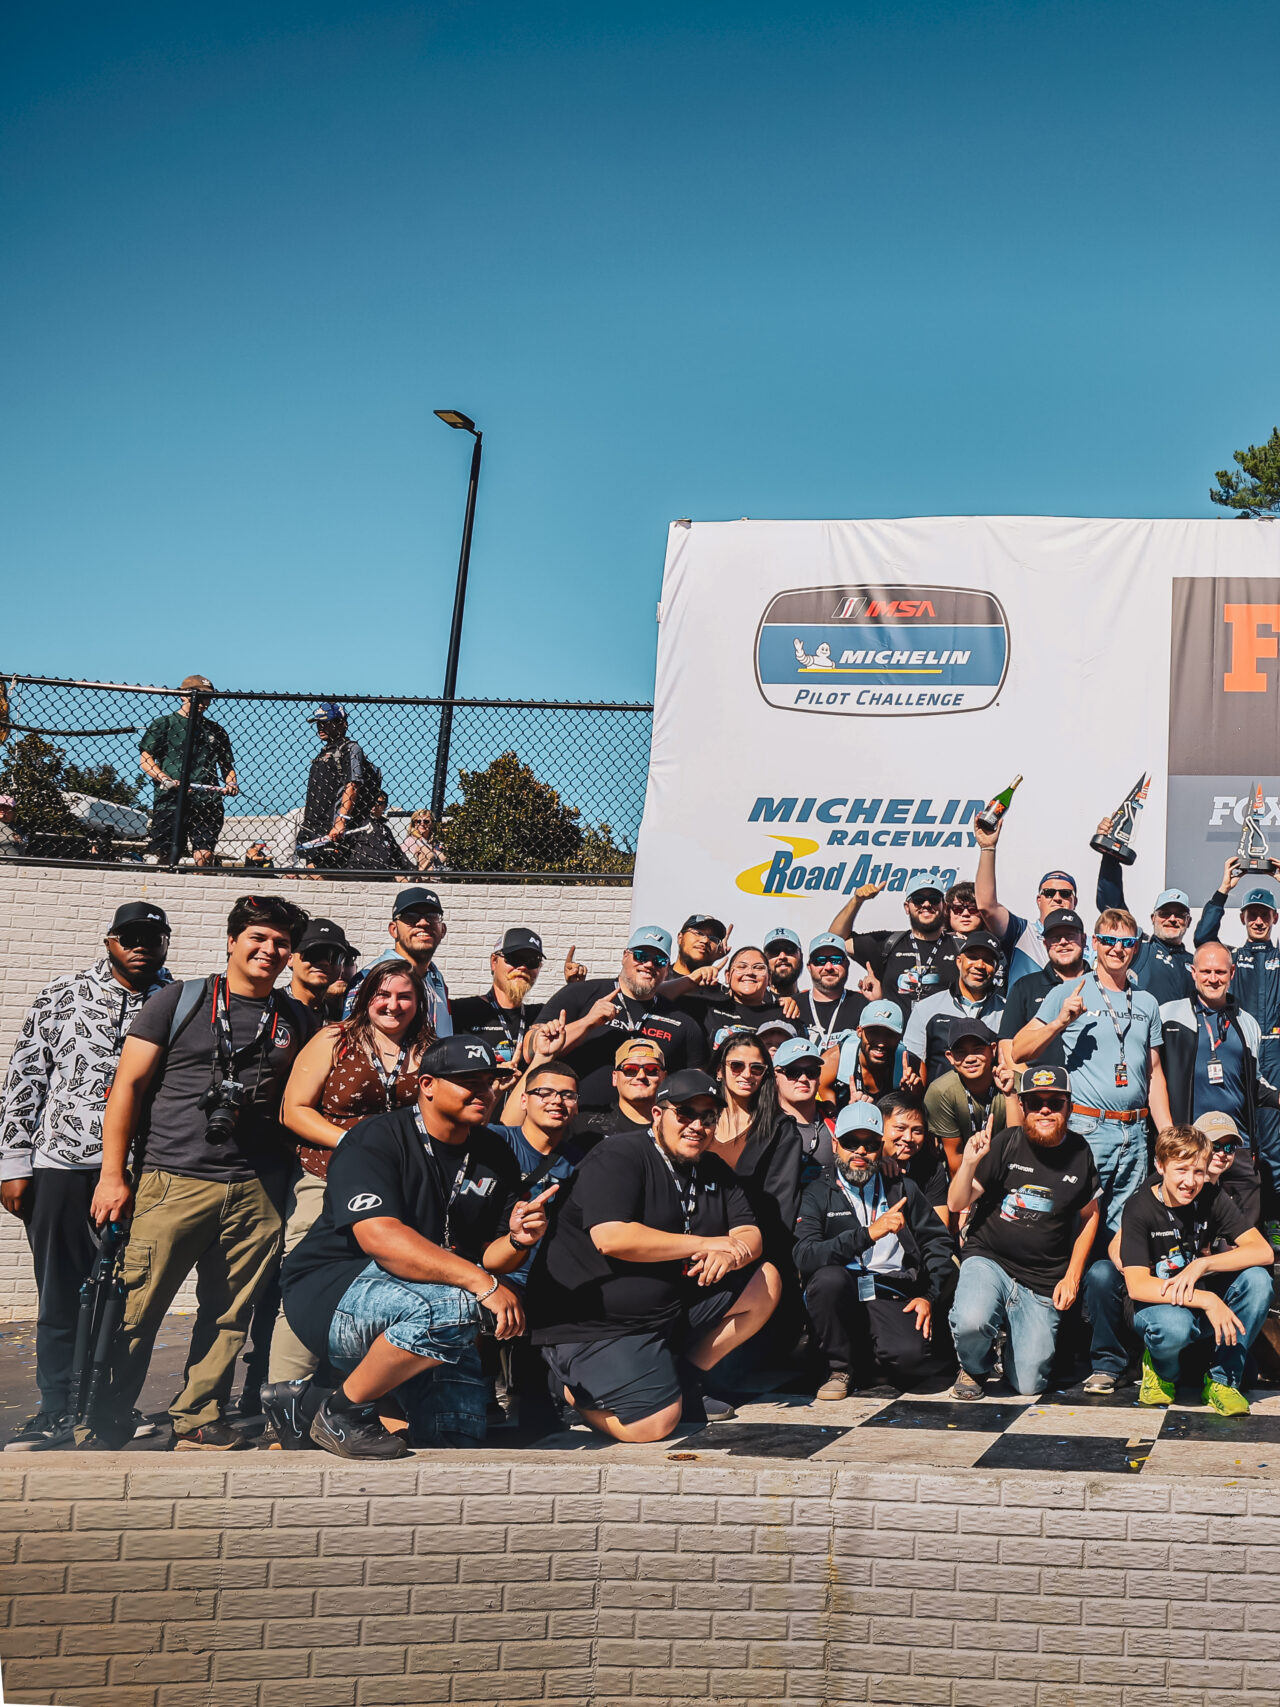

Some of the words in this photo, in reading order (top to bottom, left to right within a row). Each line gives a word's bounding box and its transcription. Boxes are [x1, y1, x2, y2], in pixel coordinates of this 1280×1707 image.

[864, 600, 936, 617] IMSA
[839, 648, 972, 665] MICHELIN
[794, 689, 851, 706] PILOT
[856, 689, 964, 706] CHALLENGE
[747, 796, 985, 824] MICHELIN
[827, 830, 977, 847] RACEWAY
[763, 851, 848, 895] Road
